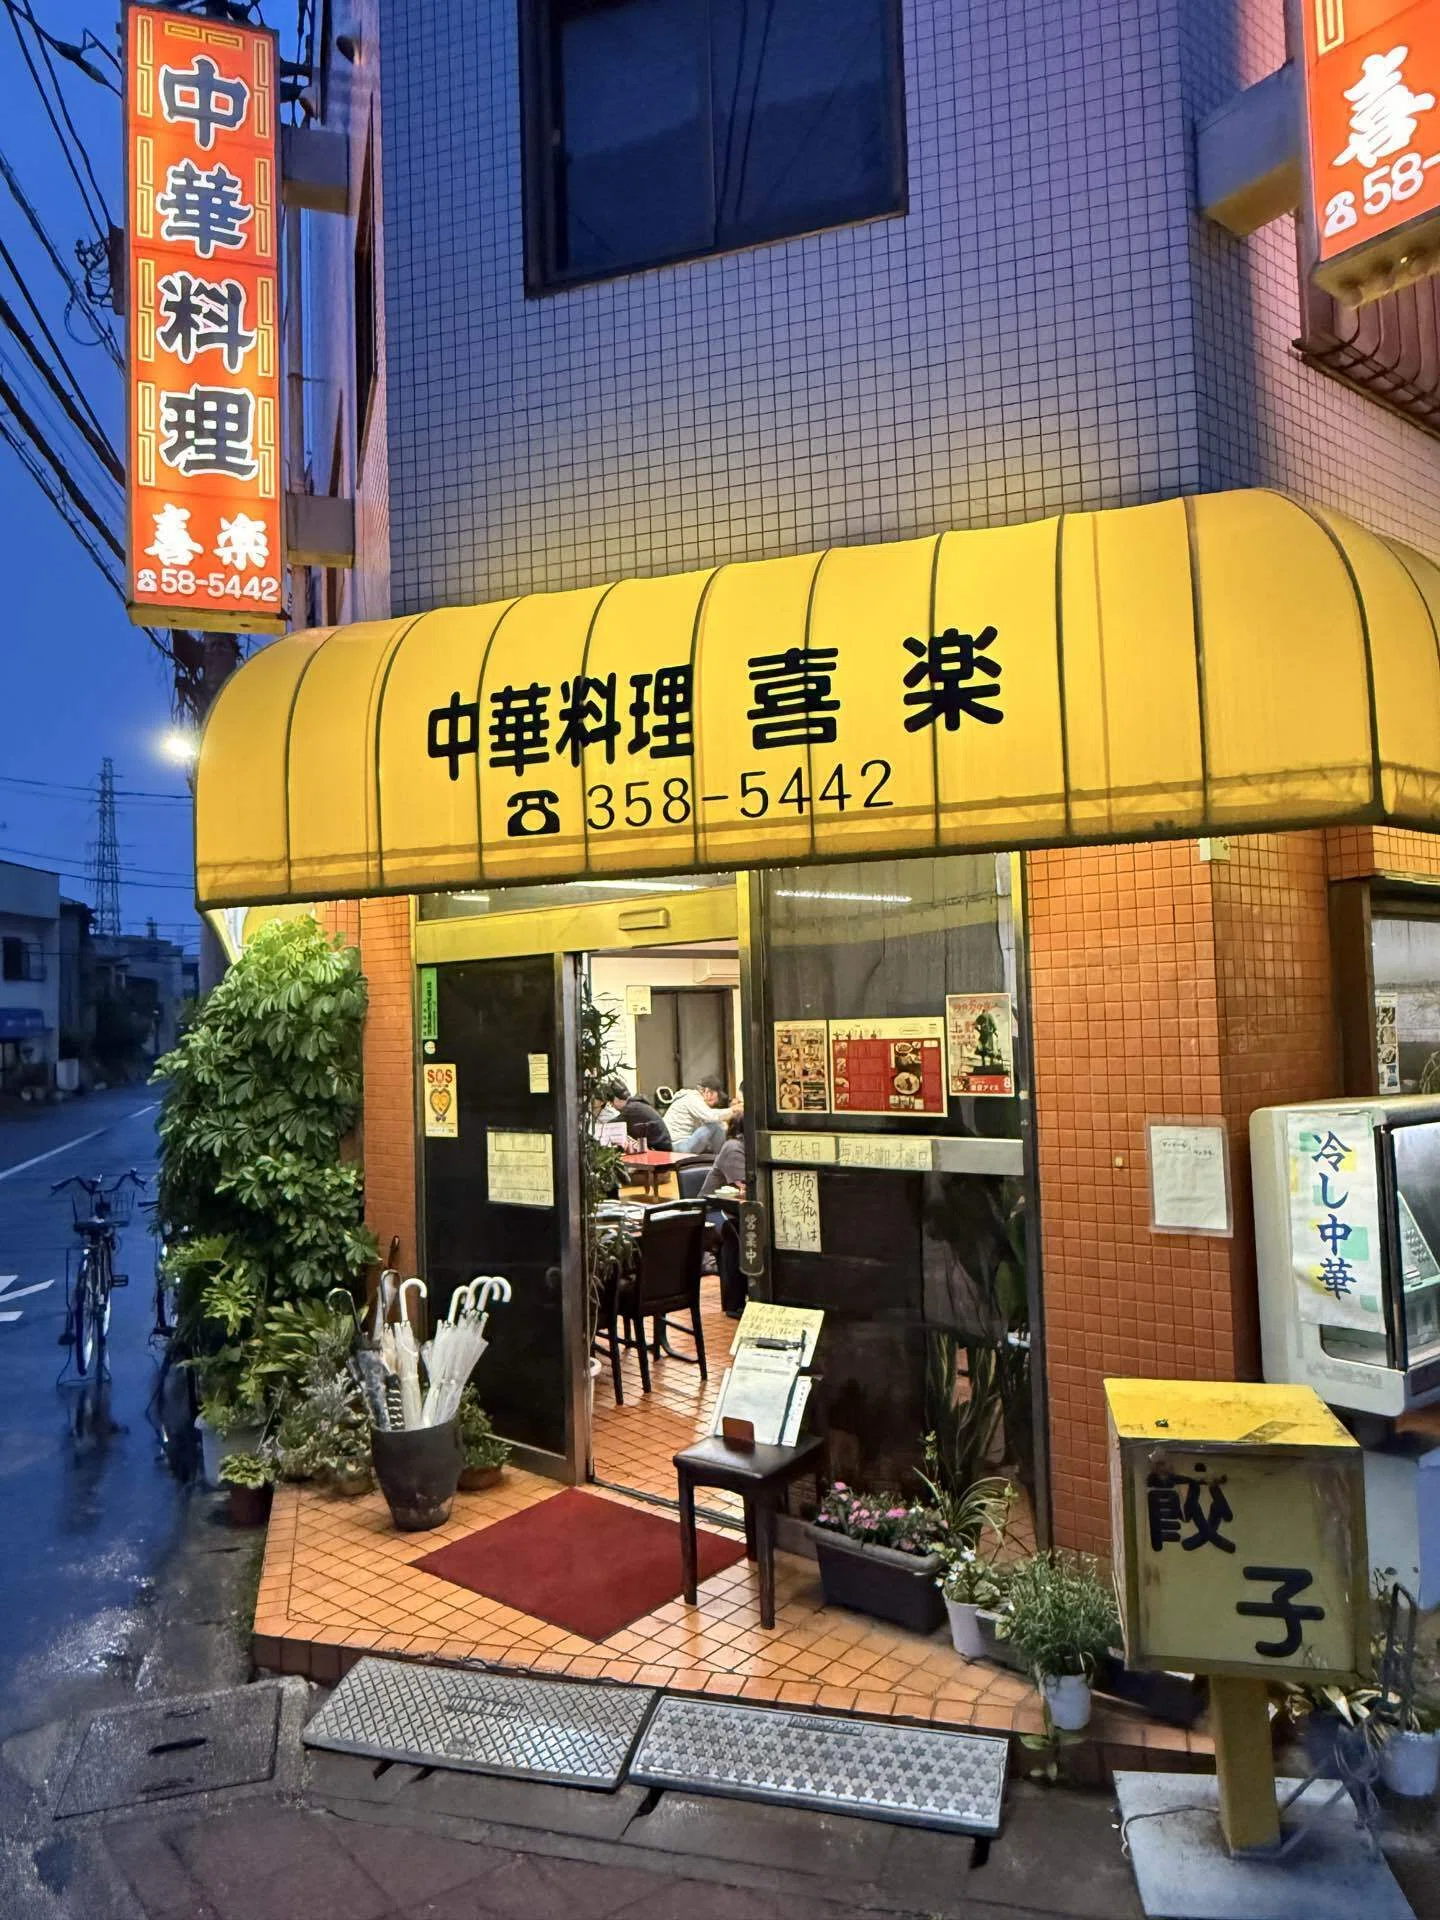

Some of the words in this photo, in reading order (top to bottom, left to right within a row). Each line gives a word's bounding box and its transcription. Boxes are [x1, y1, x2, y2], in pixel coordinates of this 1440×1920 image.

[1333, 45, 1436, 168] 喜
[156, 54, 259, 483] 中華料理
[161, 569, 280, 603] 58-5442
[428, 663, 695, 781] 中華料理
[586, 758, 894, 830] 358-5442
[427, 1069, 453, 1084] SOS
[777, 1139, 821, 1160] 定休日
[744, 1213, 758, 1265] 営業中
[1312, 1130, 1356, 1300] 冷し中華
[1146, 1462, 1325, 1657] 餃子
